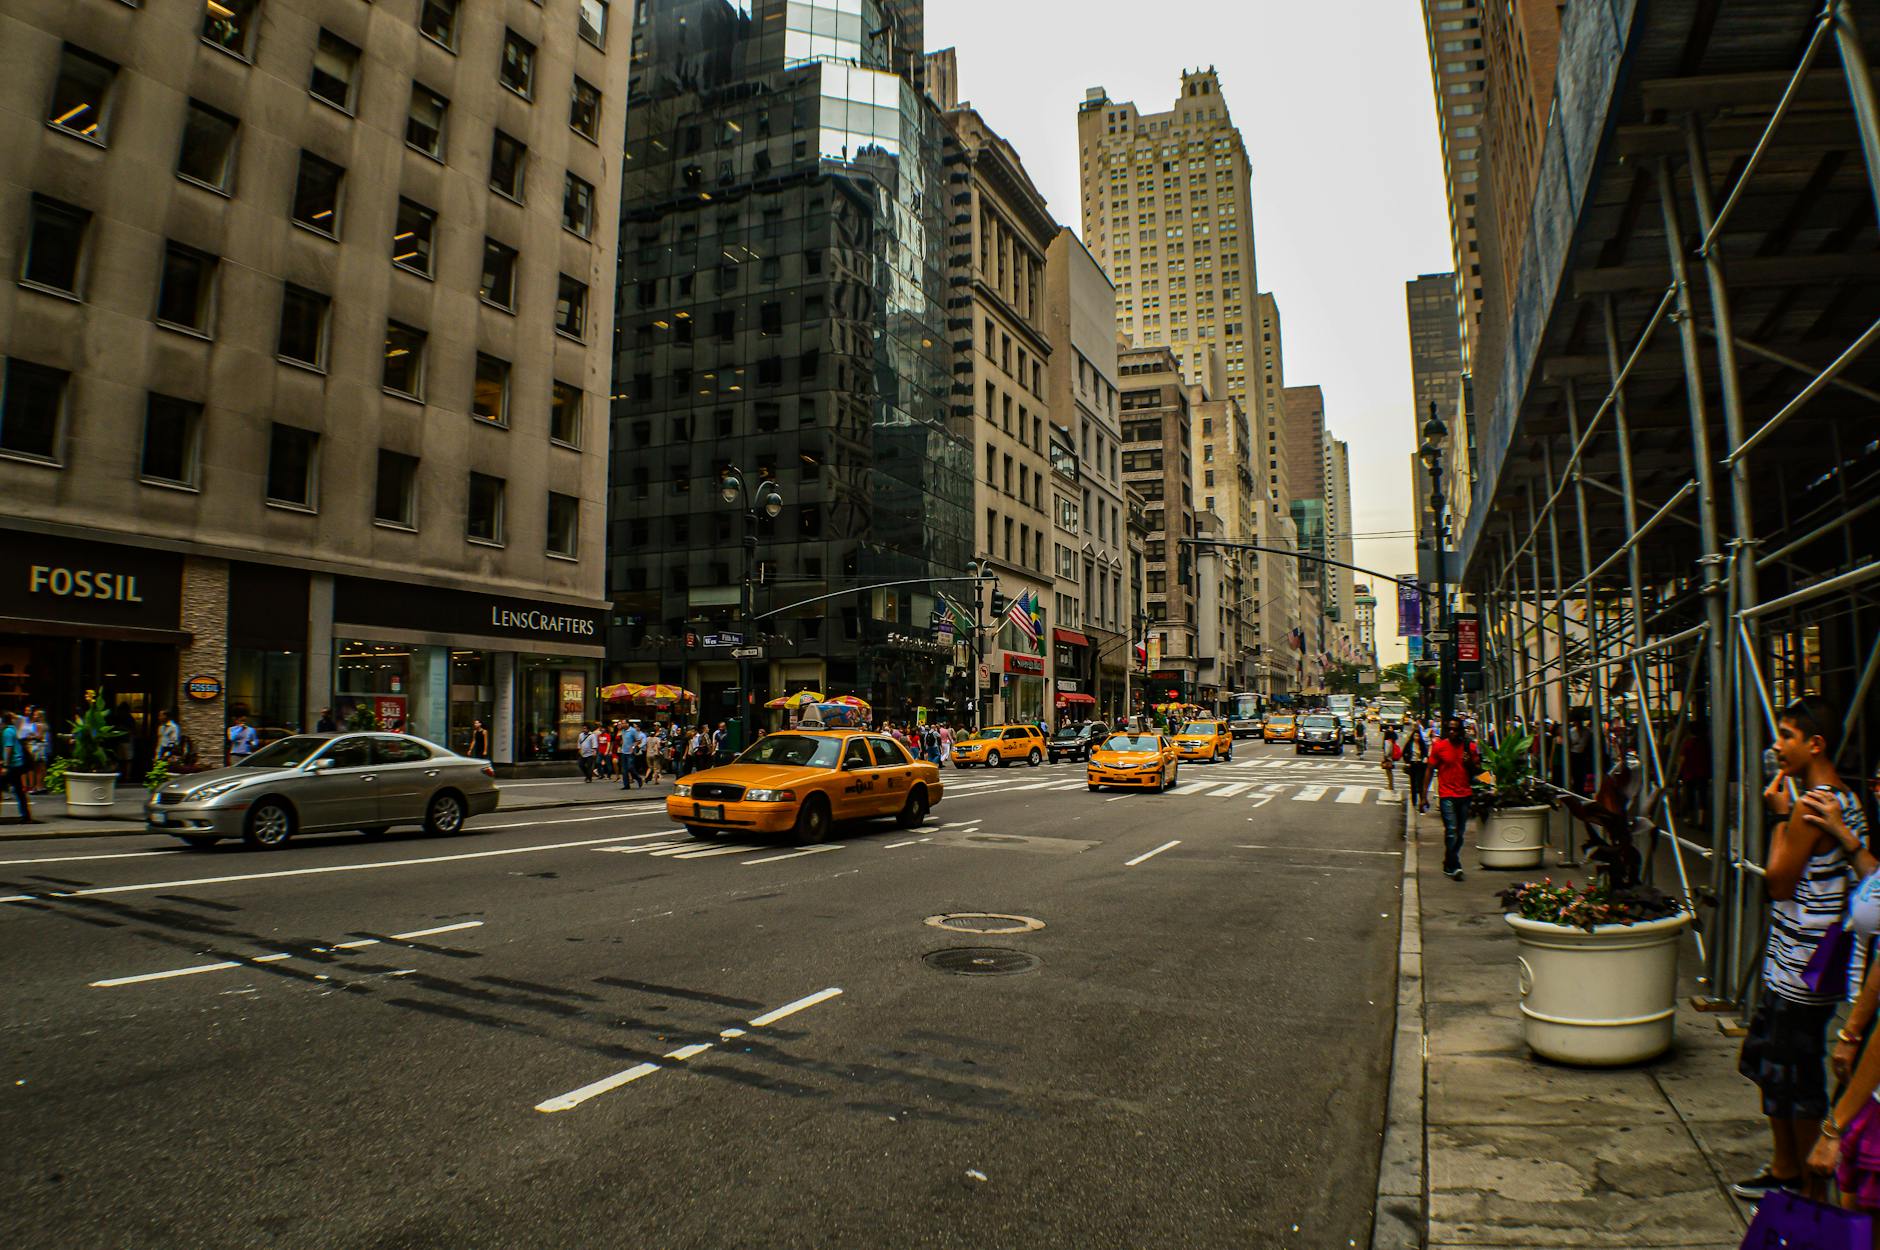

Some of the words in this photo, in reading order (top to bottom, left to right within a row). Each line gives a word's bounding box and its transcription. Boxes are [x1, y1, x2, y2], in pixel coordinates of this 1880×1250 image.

[29, 564, 143, 603] FOSSIL
[190, 682, 220, 694] FOSSIL
[563, 690, 582, 701] SALE
